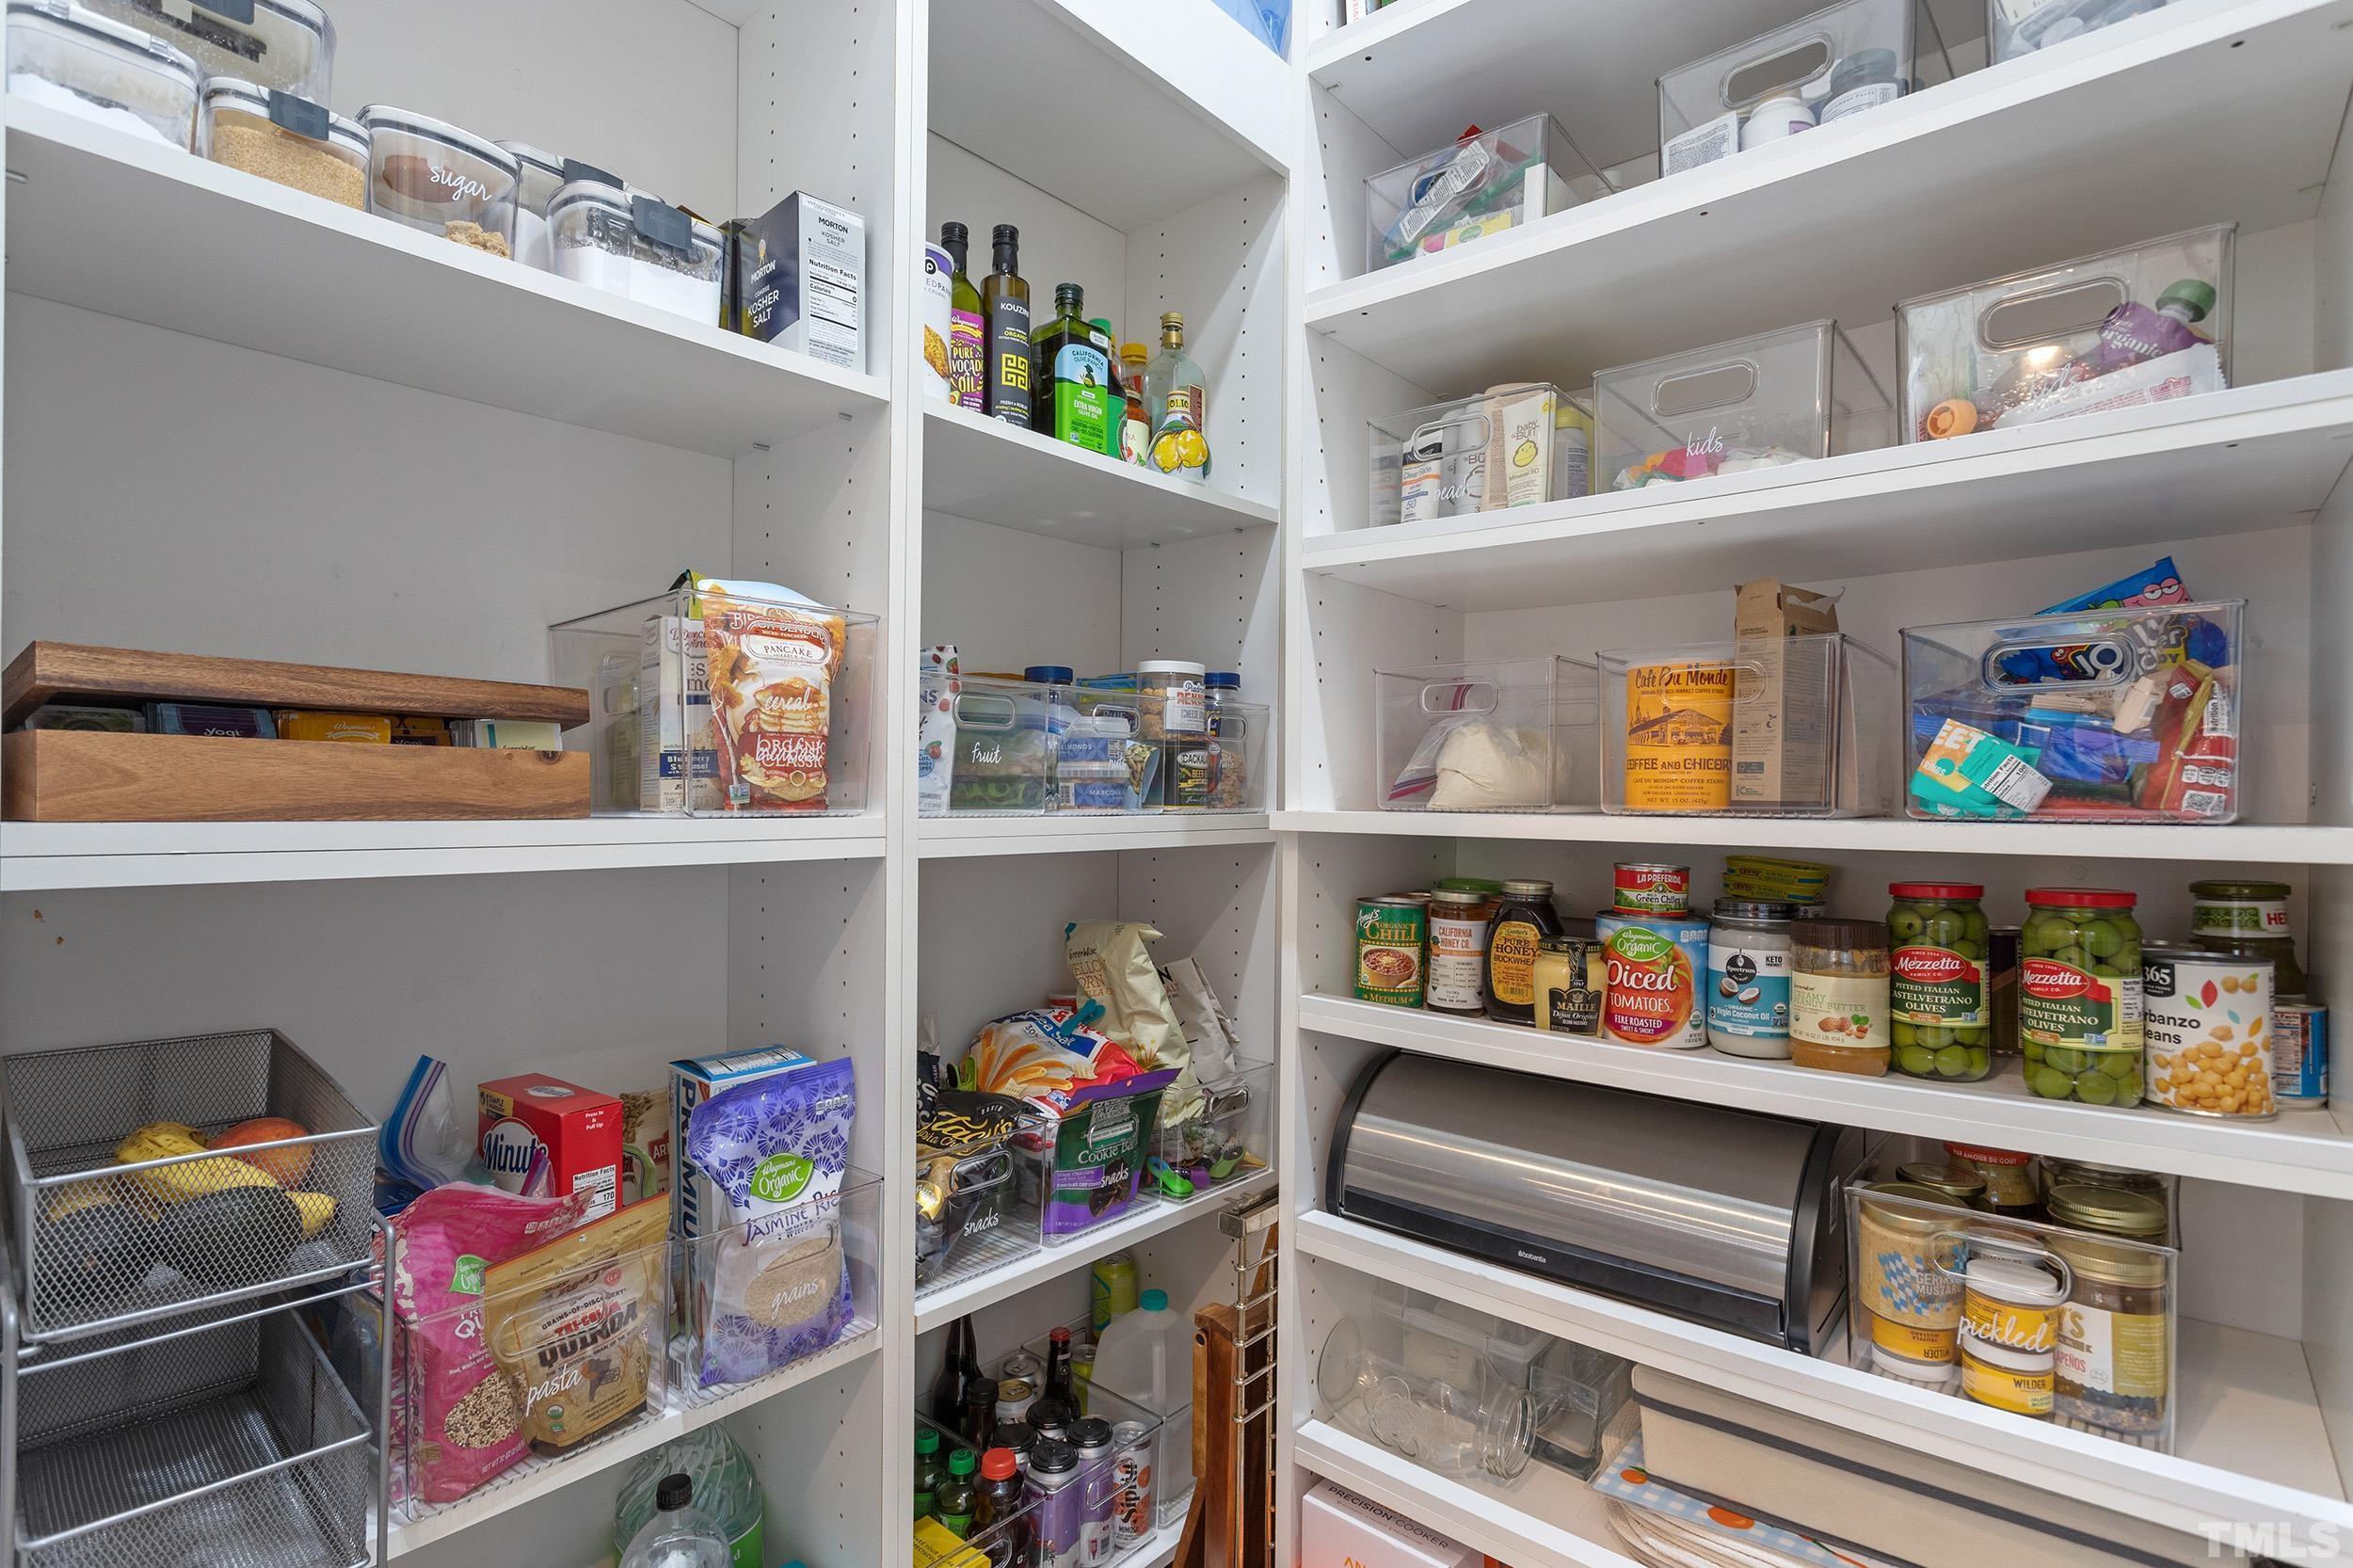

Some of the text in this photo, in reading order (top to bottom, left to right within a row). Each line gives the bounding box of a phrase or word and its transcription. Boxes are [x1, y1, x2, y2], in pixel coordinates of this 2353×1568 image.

[430, 166, 492, 200] sugar
[818, 216, 849, 234] MORTON
[822, 231, 845, 244] KOSHER
[826, 238, 840, 248] SALT
[750, 260, 776, 283] MORTON
[808, 258, 839, 274] Nutrition
[840, 268, 857, 280] Facts
[809, 282, 832, 295] Calories
[747, 290, 779, 317] KOSHER
[753, 307, 773, 328] SALT
[952, 345, 974, 360] PURE
[1072, 350, 1104, 367] CALIFORNIA
[958, 376, 977, 392] OIL
[1687, 426, 1723, 457] kids
[1403, 470, 1420, 481] Clear
[1509, 471, 1529, 482] Mineral
[1433, 483, 1471, 502] beach
[1405, 500, 1417, 510] 50
[763, 645, 813, 659] PANCAKE
[1636, 667, 1657, 689] Café
[1686, 668, 1729, 686] Monde
[765, 687, 812, 712] cereal
[972, 742, 1001, 763] fruit
[1626, 758, 1680, 770] COFFEE AND
[2000, 756, 2015, 772] Facts
[2016, 764, 2027, 776] 100
[1637, 873, 1682, 885] LA PREFERIDA
[1636, 894, 1659, 904] Green
[1356, 908, 1382, 931] Amy's
[1366, 921, 1417, 941] CHILI
[1438, 926, 1473, 938] CALIFORNIA
[1622, 930, 1657, 941] Wegmans
[1439, 937, 1471, 950] HONEY CO.
[1504, 937, 1530, 948] PURE
[1617, 940, 1660, 956] Organic
[1495, 944, 1539, 957] HONEY
[1494, 954, 1535, 966] BUCKWHEA
[1765, 955, 1783, 964] KETO
[1895, 956, 1961, 970] Mezzetta
[1608, 959, 1678, 991] Diced
[1726, 965, 1756, 975] Spectrum
[2023, 968, 2083, 985] Mezzetta
[2144, 966, 2171, 985] 365
[1896, 983, 1961, 994] PITTED ITALIAN
[1369, 993, 1410, 1004] MEDIUM
[1609, 994, 1672, 1013] TOMATOES
[1892, 991, 1973, 1005] ASTELVETRANO
[2041, 998, 2081, 1013] ITALIAN
[1557, 1001, 1596, 1012] MAILLE
[1717, 1007, 1769, 1020] Virgin Coconut Oil
[1827, 1001, 1866, 1012] BUTTER
[1905, 1001, 1946, 1014] OLIVES
[1553, 1010, 1571, 1020] Dijon
[1614, 1014, 1663, 1029] FIRE ROASTED
[2023, 1006, 2099, 1026] STELVETRANO
[2144, 1009, 2201, 1030] rbanzo
[2027, 1017, 2066, 1032] OLIVES
[1051, 1032, 1077, 1047] Salt
[2146, 1029, 2182, 1045] eans
[1078, 1145, 1118, 1164] Cookie
[1964, 1151, 1986, 1162] AMOUR
[574, 1165, 615, 1182] Nutrition Facts
[761, 1160, 796, 1176] Wegmans
[1100, 1162, 1129, 1188] snacks
[759, 1165, 804, 1197] Organic
[602, 1191, 615, 1201] 170
[742, 1206, 809, 1247] JASMINE
[964, 1206, 1000, 1237] snacks
[771, 1277, 820, 1320] grains
[537, 1301, 638, 1369] QUINOA
[1956, 1311, 2051, 1353] pickled
[593, 1344, 609, 1356] GRAIN
[1924, 1347, 1950, 1359] WILDER
[525, 1363, 583, 1417] pasta
[2013, 1377, 2046, 1391] WILDER
[1328, 1485, 1449, 1550] PRECISION COOKER
